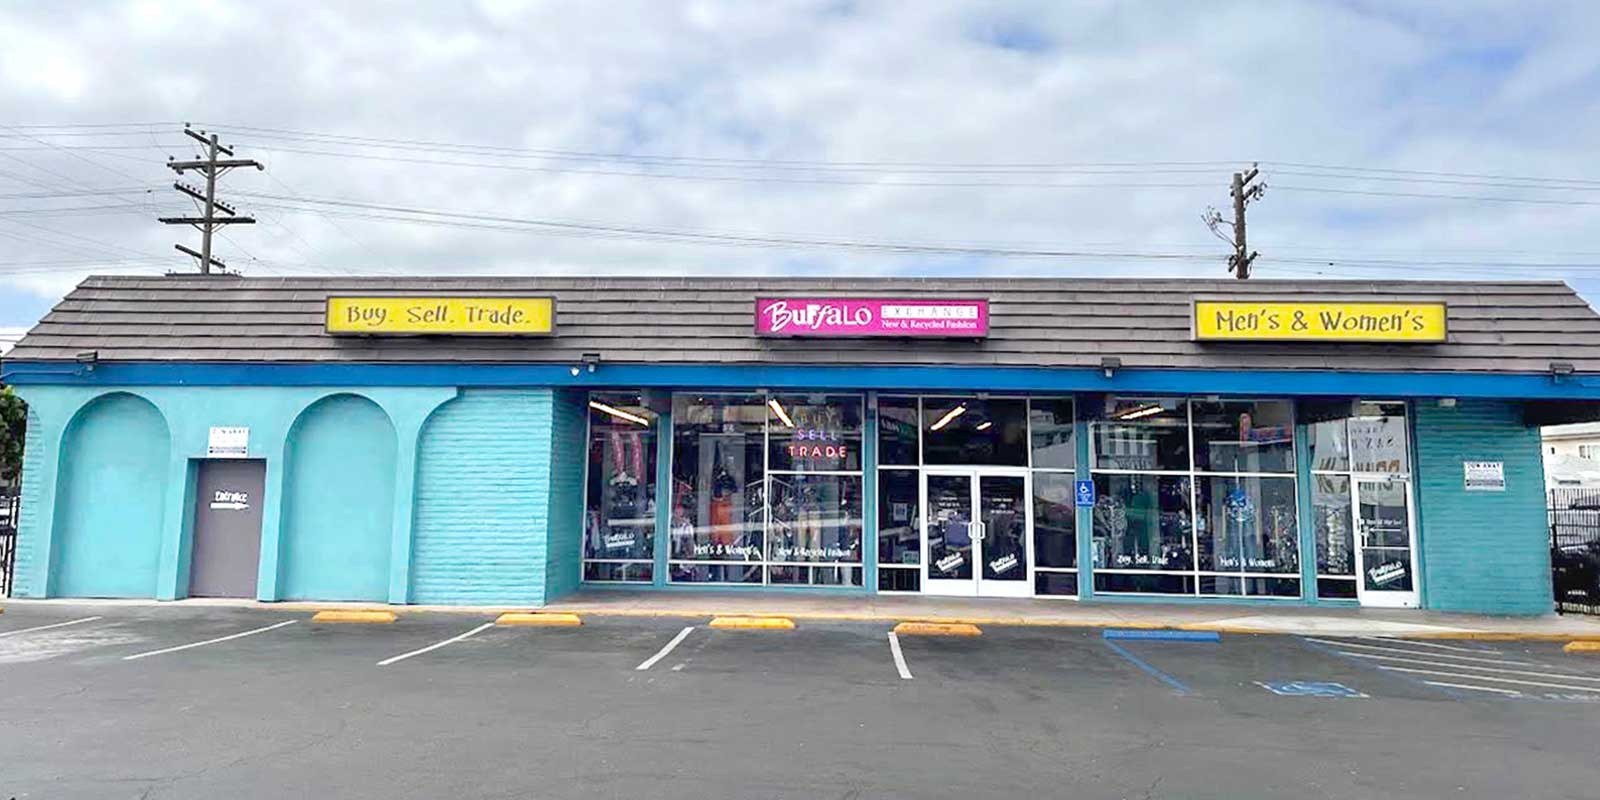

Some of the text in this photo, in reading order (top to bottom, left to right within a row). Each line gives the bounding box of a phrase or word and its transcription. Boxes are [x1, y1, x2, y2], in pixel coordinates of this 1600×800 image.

[881, 320, 977, 330] New & Recycled Fashion
[1215, 309, 1424, 332] Men's & Women's
[797, 429, 837, 440] SELL
[788, 445, 847, 458] TRADE
[693, 544, 715, 555] Men's
